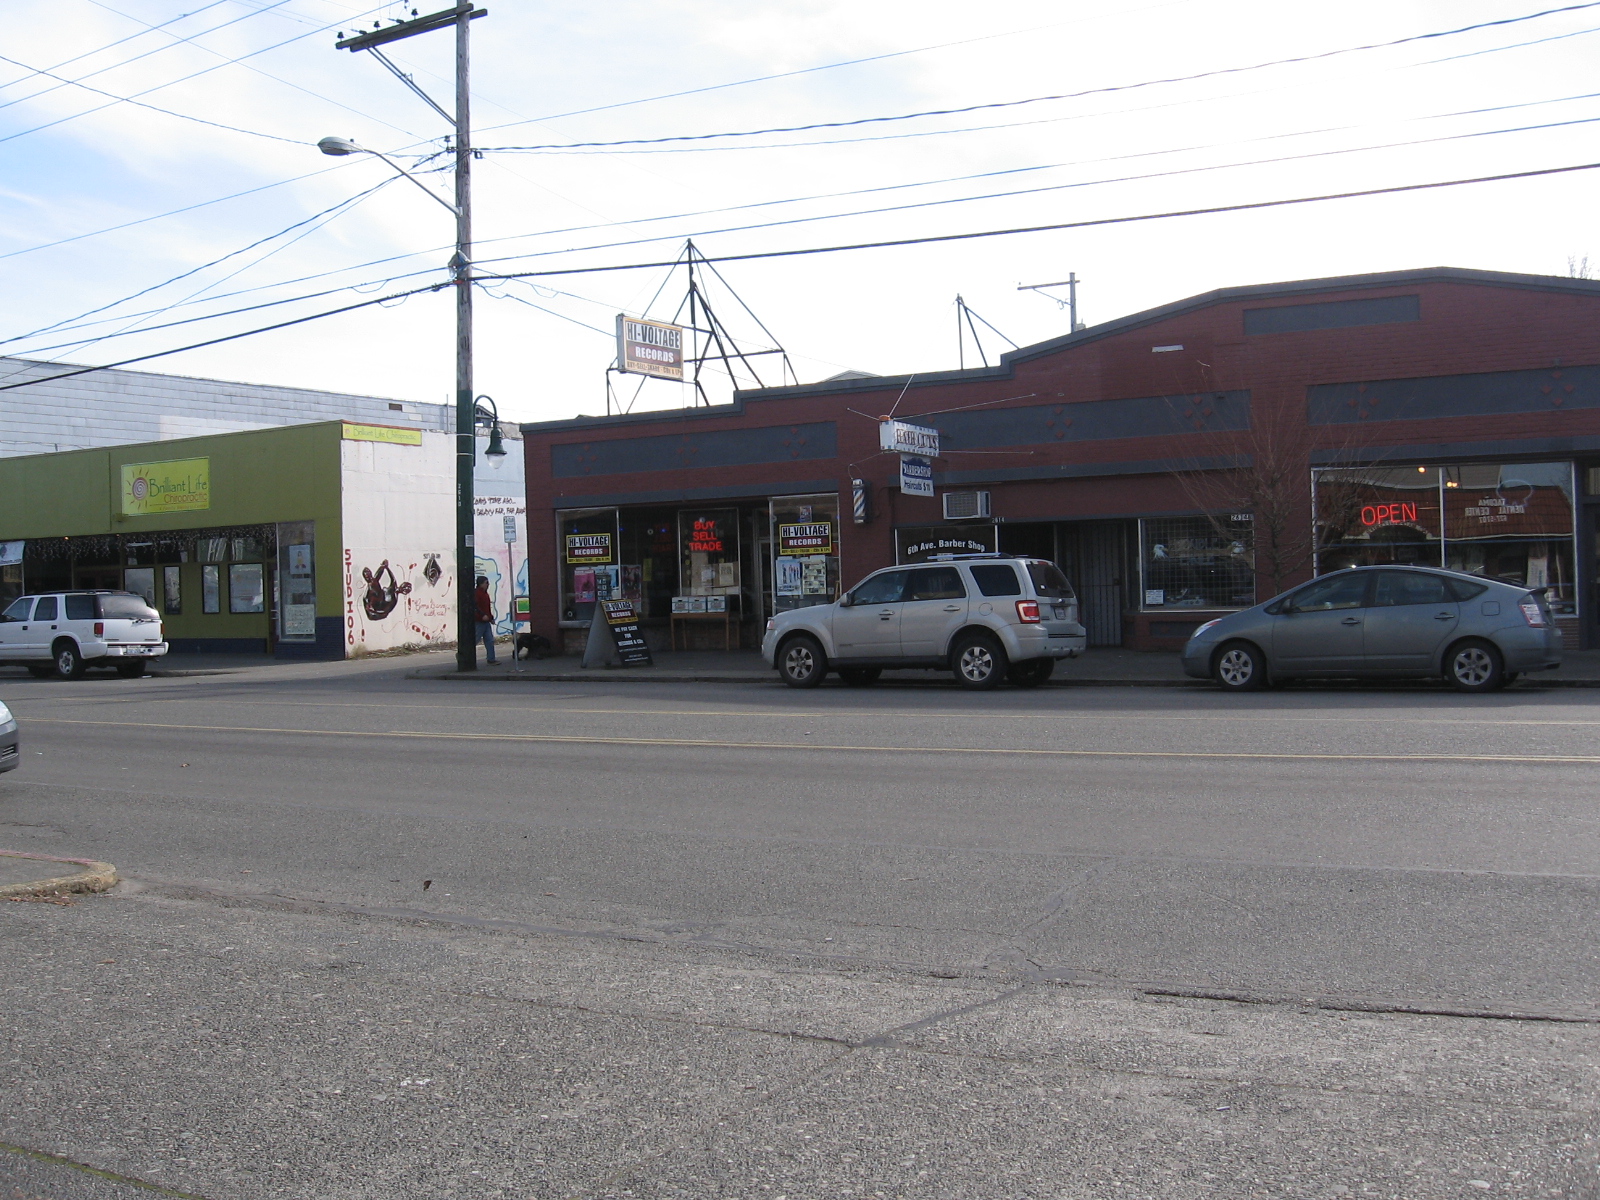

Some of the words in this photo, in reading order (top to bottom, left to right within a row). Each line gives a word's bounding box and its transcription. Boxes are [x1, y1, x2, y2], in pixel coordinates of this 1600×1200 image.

[627, 322, 680, 348] HI-VOLTAGE
[635, 346, 674, 363] RECORDS
[149, 476, 185, 497] Brilliant
[188, 474, 208, 494] Life
[164, 493, 207, 504] Chiropractic
[1361, 502, 1417, 526] OPEN
[694, 520, 716, 530] BUY
[692, 531, 717, 541] SELL
[783, 525, 828, 537] HI-VOLTAGE
[569, 535, 609, 547] HI-VOLTAGE
[688, 541, 723, 551] TRADE
[789, 538, 822, 546] RECORDS
[574, 548, 603, 556] RECORDS
[907, 546, 918, 555] 6th
[920, 542, 937, 551] Ave.
[938, 539, 966, 548] Barber
[968, 540, 985, 553] Shop
[604, 601, 633, 611] HI-VOLTAGE
